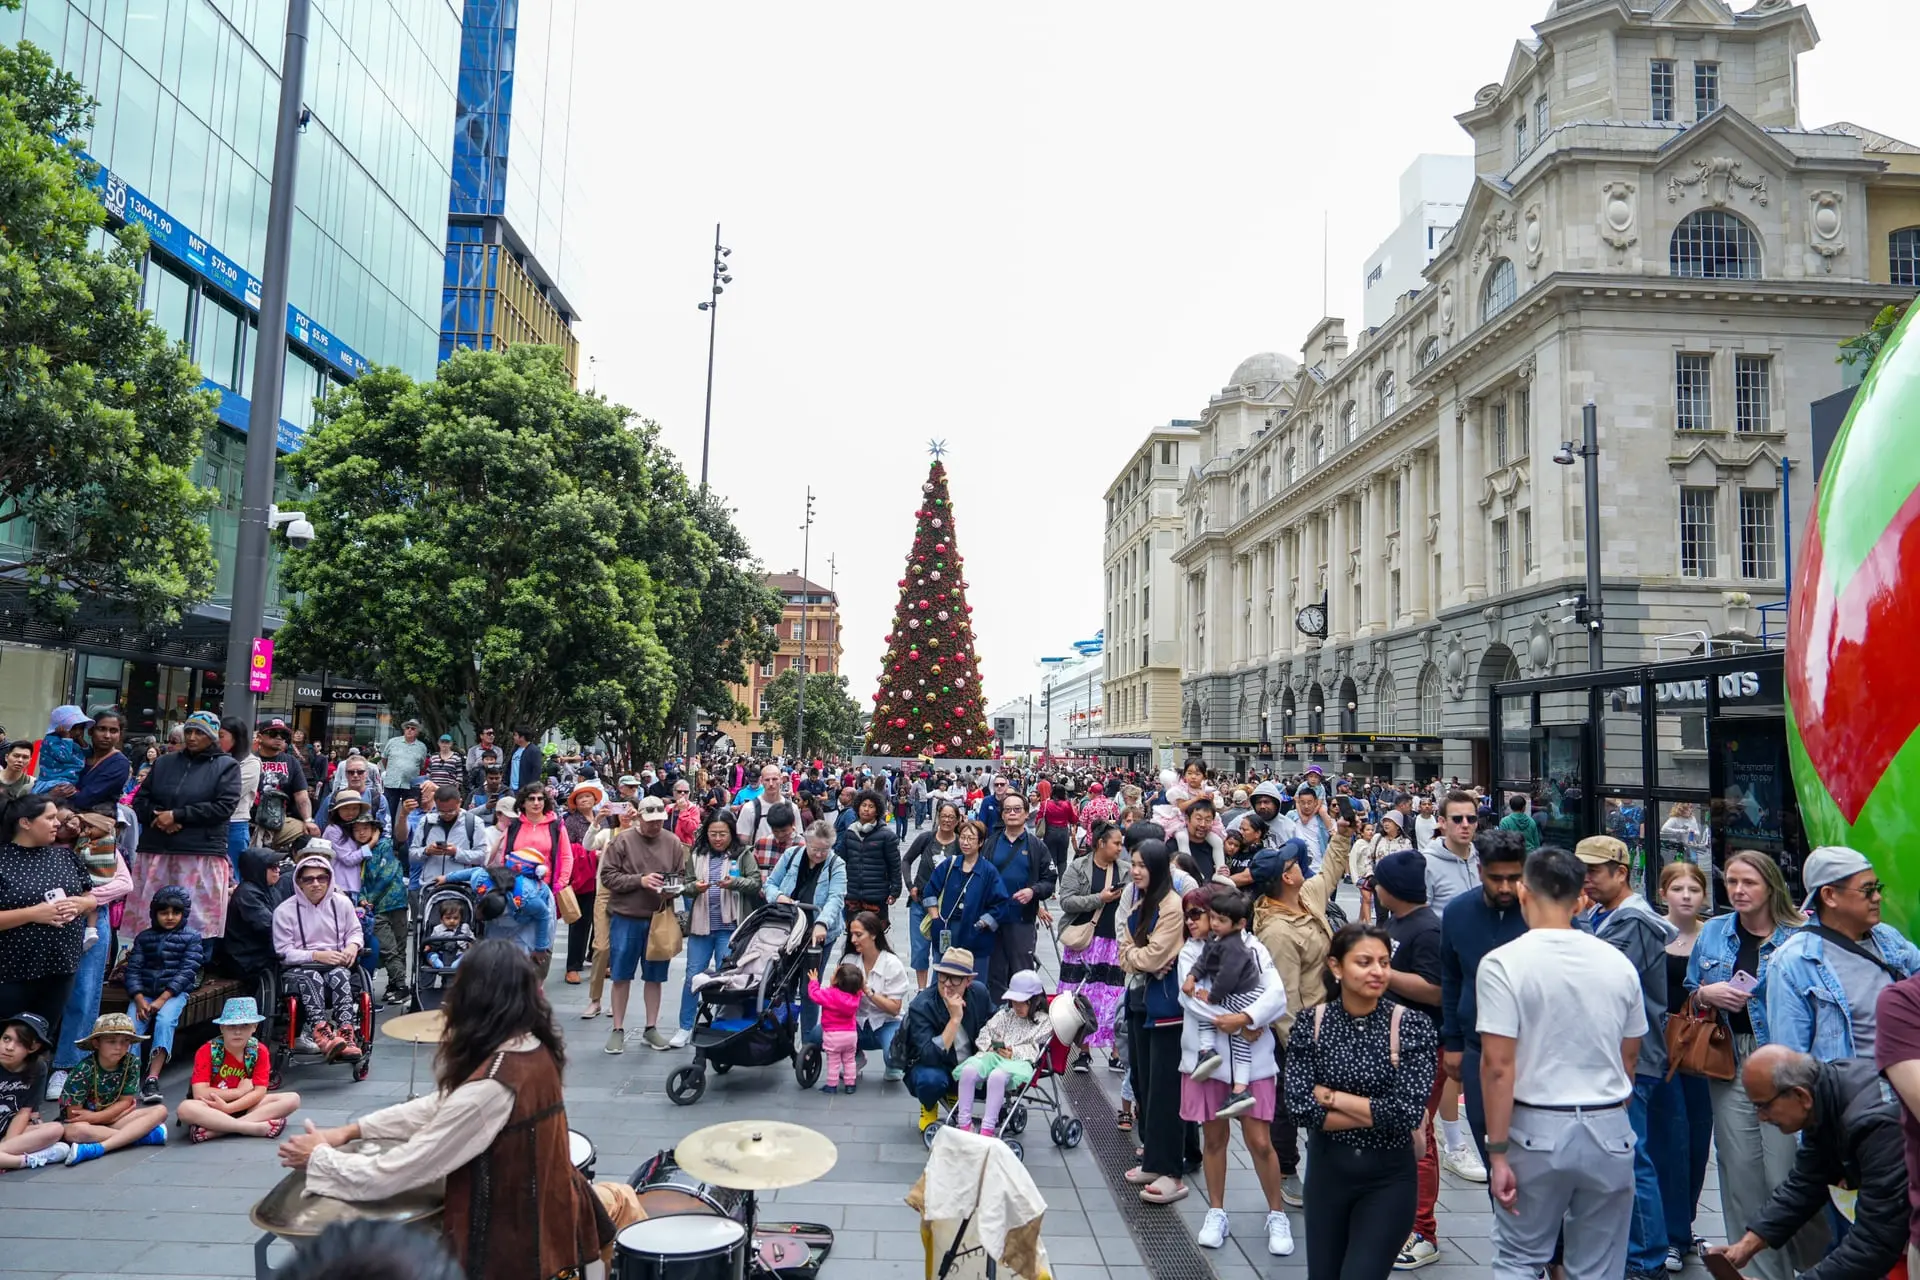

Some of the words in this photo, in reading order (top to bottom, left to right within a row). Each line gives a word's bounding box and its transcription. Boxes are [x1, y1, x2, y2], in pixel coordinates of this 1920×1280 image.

[106, 180, 126, 209] 50
[104, 198, 125, 220] INDEX
[130, 196, 172, 235] 13041.90
[188, 234, 207, 256] MFT
[211, 255, 237, 281] $75.00
[247, 277, 262, 295] PCT
[296, 312, 310, 329] POT
[312, 328, 328, 346] $5.95
[298, 687, 321, 697] COAC
[332, 691, 382, 700] COACH
[262, 761, 289, 776] RIBAL
